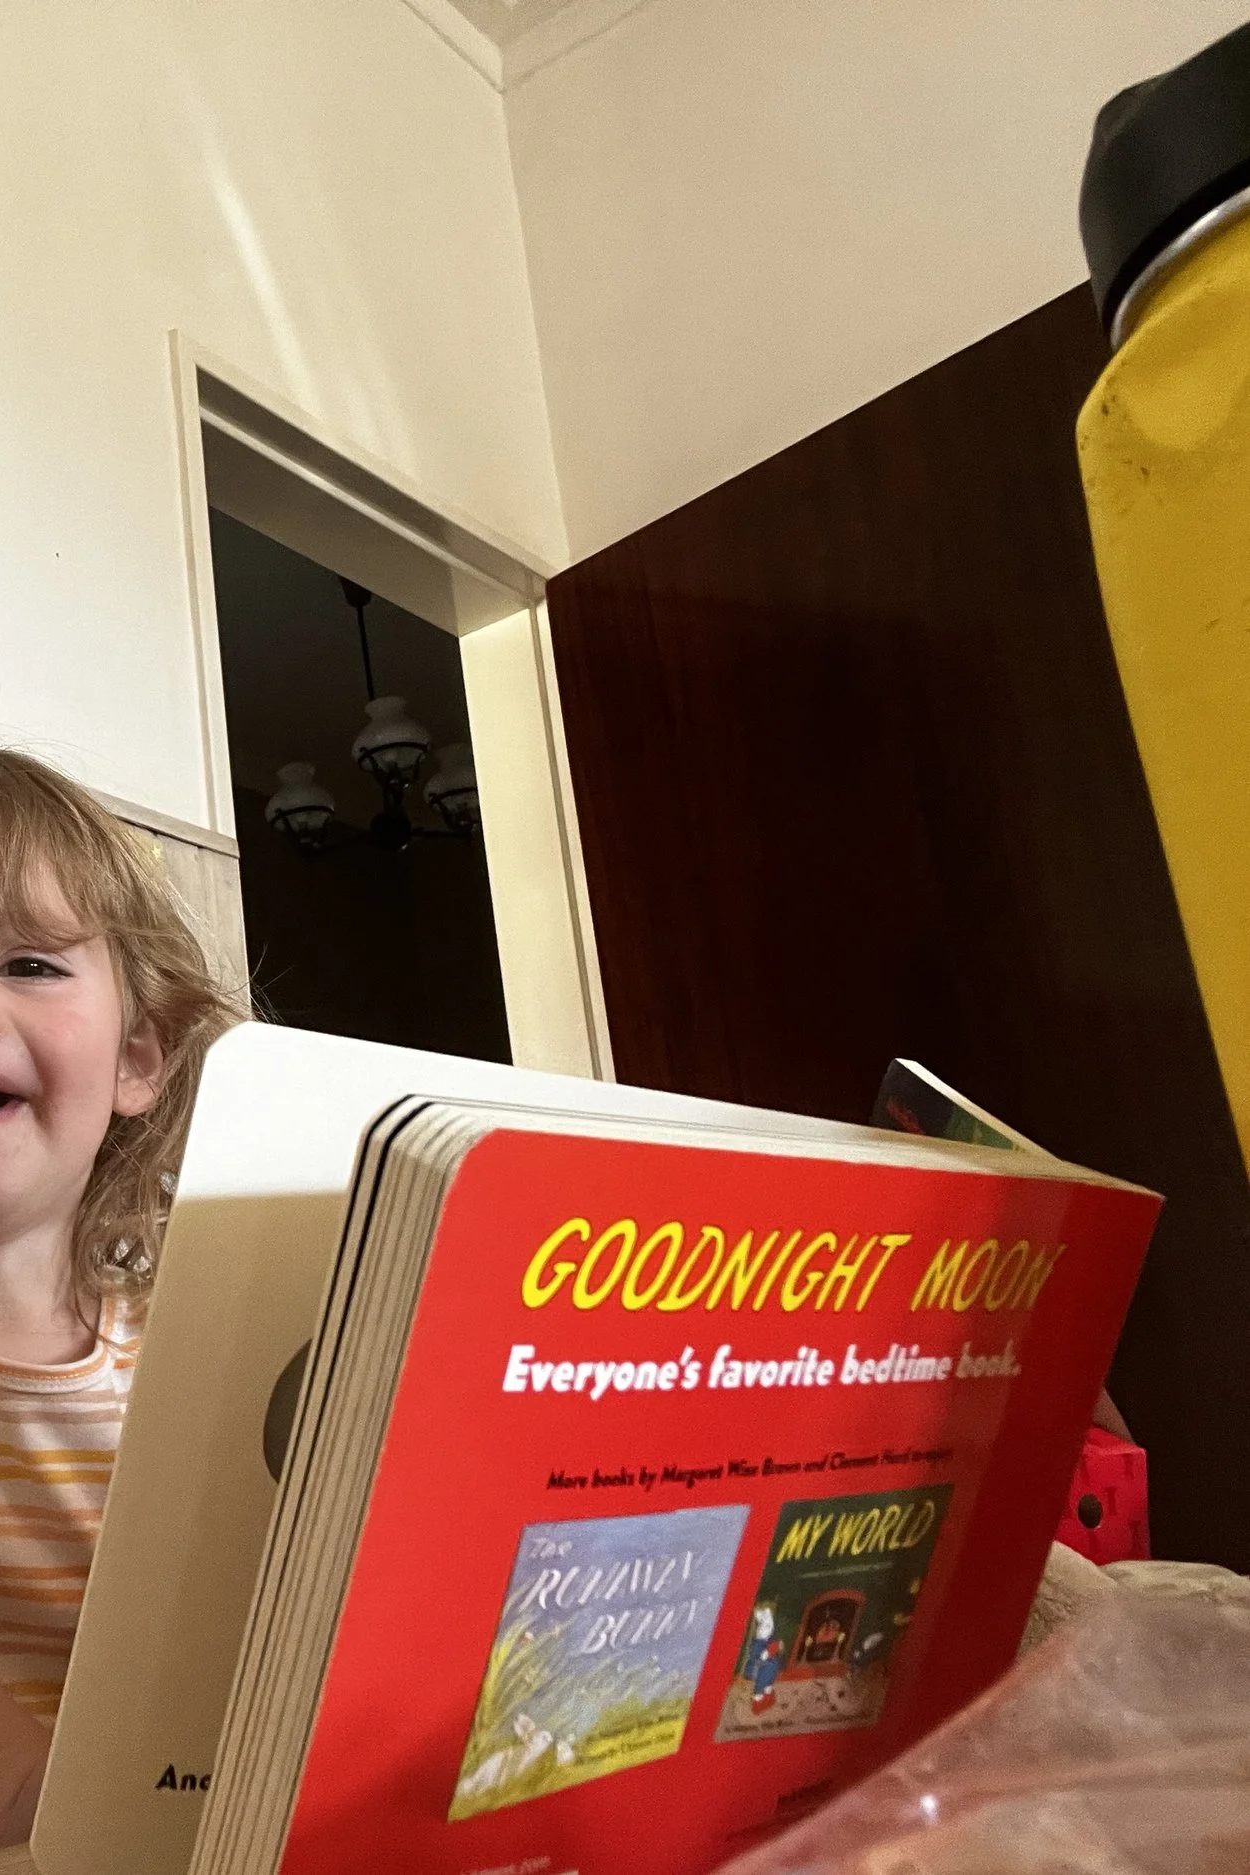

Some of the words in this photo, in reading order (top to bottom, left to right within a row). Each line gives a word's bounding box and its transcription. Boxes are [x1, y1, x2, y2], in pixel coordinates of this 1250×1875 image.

[521, 1217, 912, 1313] GOODNIGHT
[910, 1238, 1069, 1312] MOON
[502, 1343, 703, 1401] Everyone's
[707, 1343, 835, 1388] favorite
[840, 1343, 952, 1384] bedtime
[956, 1340, 1023, 1379] book.
[775, 1512, 834, 1564] MY
[827, 1500, 935, 1557] WORLD
